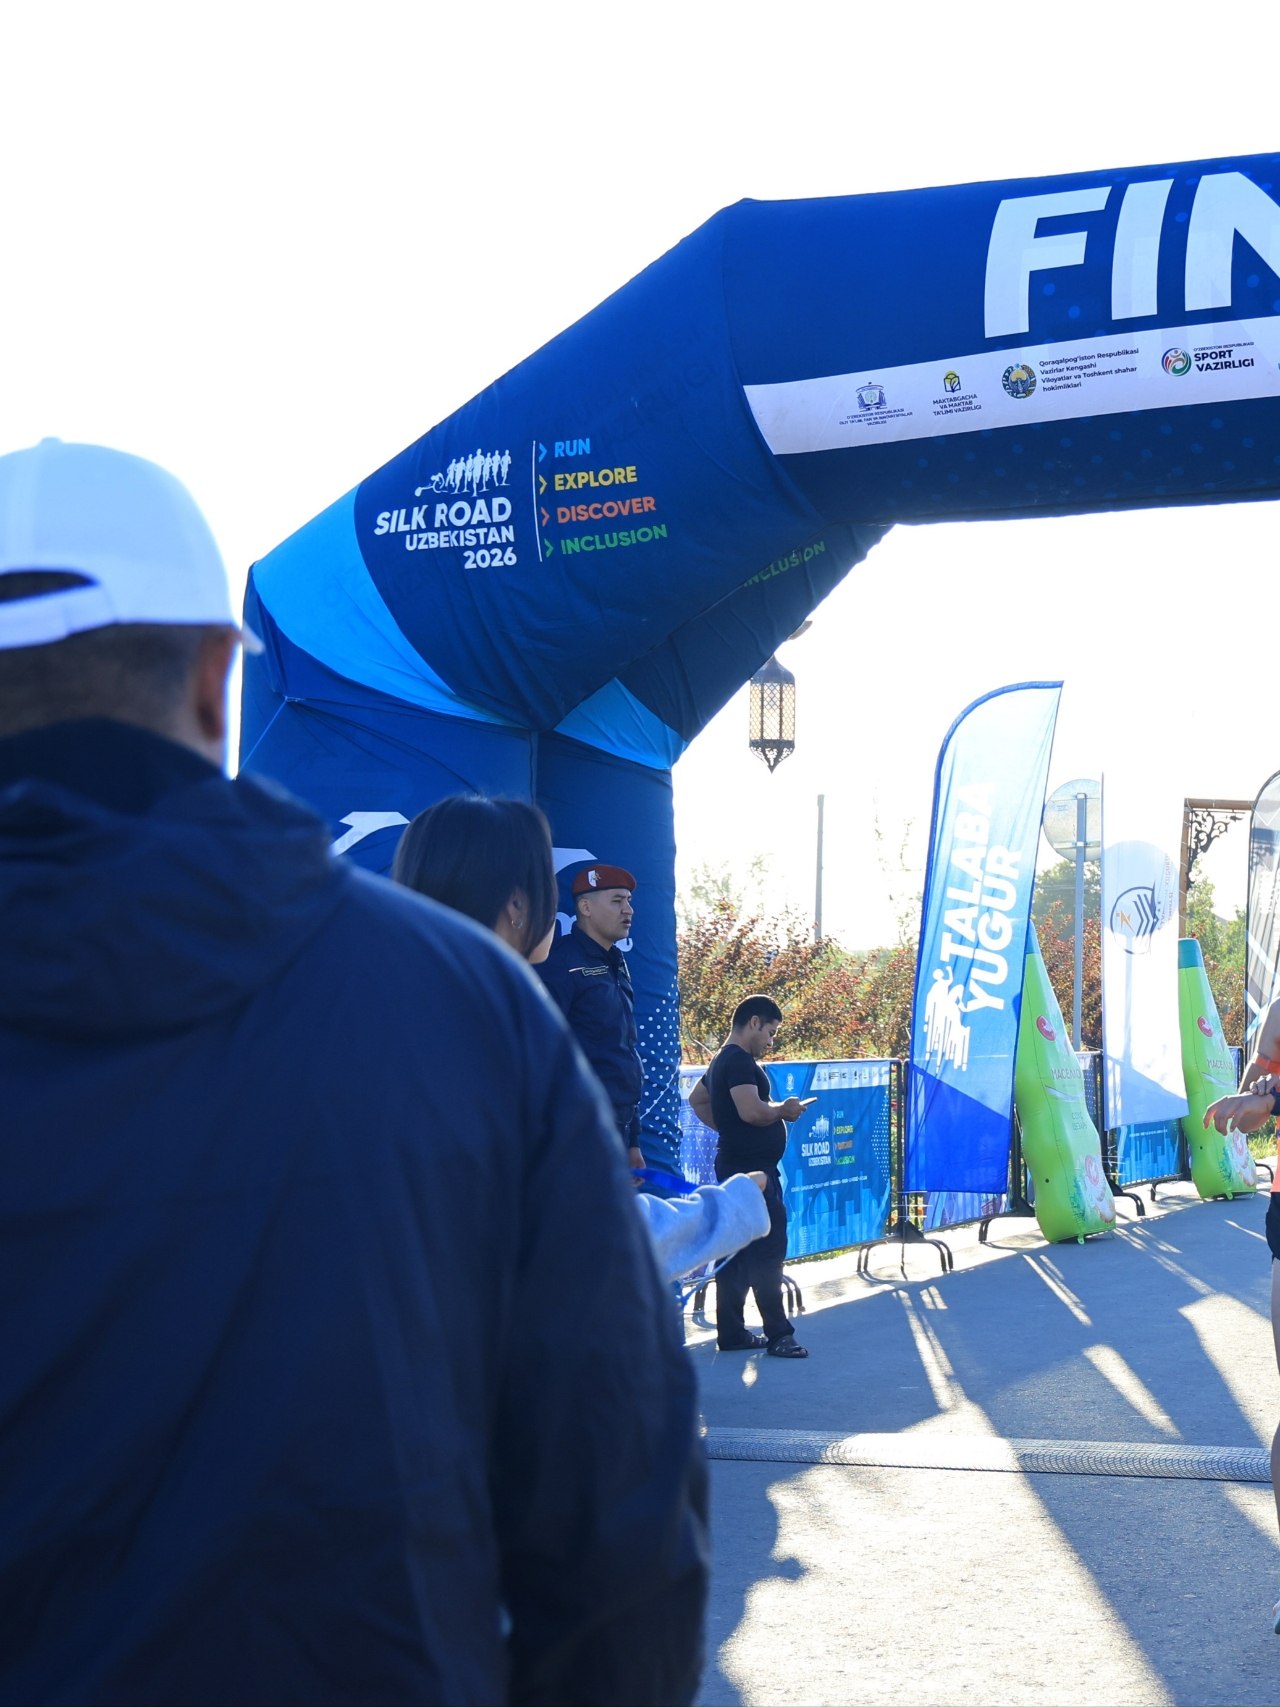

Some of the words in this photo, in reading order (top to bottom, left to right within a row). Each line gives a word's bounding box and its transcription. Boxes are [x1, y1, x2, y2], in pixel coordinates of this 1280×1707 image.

[1097, 348, 1140, 359] Respublikasi
[1194, 350, 1233, 361] SPORT
[1040, 366, 1065, 375] Vazirlar
[1066, 362, 1097, 372] Kengashi
[1196, 358, 1254, 372] VAZIRLIGI
[1041, 374, 1072, 384] Viloyatlar
[1083, 369, 1113, 379] Toshkent
[1114, 366, 1138, 374] shahar
[1043, 382, 1082, 392] hokimliklari
[933, 394, 977, 405] MAKTABGACHA
[948, 400, 973, 409] MAKTAB
[954, 405, 982, 414] VAZIRLIGI
[554, 438, 591, 458] RUN
[554, 466, 638, 491] EXPLORE
[374, 501, 426, 535] SILK
[434, 497, 512, 526] ROAD
[556, 496, 656, 524] DISCOVER
[405, 525, 514, 551] UZBEKISTAN
[560, 523, 668, 555] INCLUSION
[463, 549, 517, 569] 2026
[940, 783, 996, 962] TALABA
[967, 844, 1022, 1011] YUGUR
[801, 1142, 813, 1157] SILK
[813, 1141, 830, 1155] ROAD
